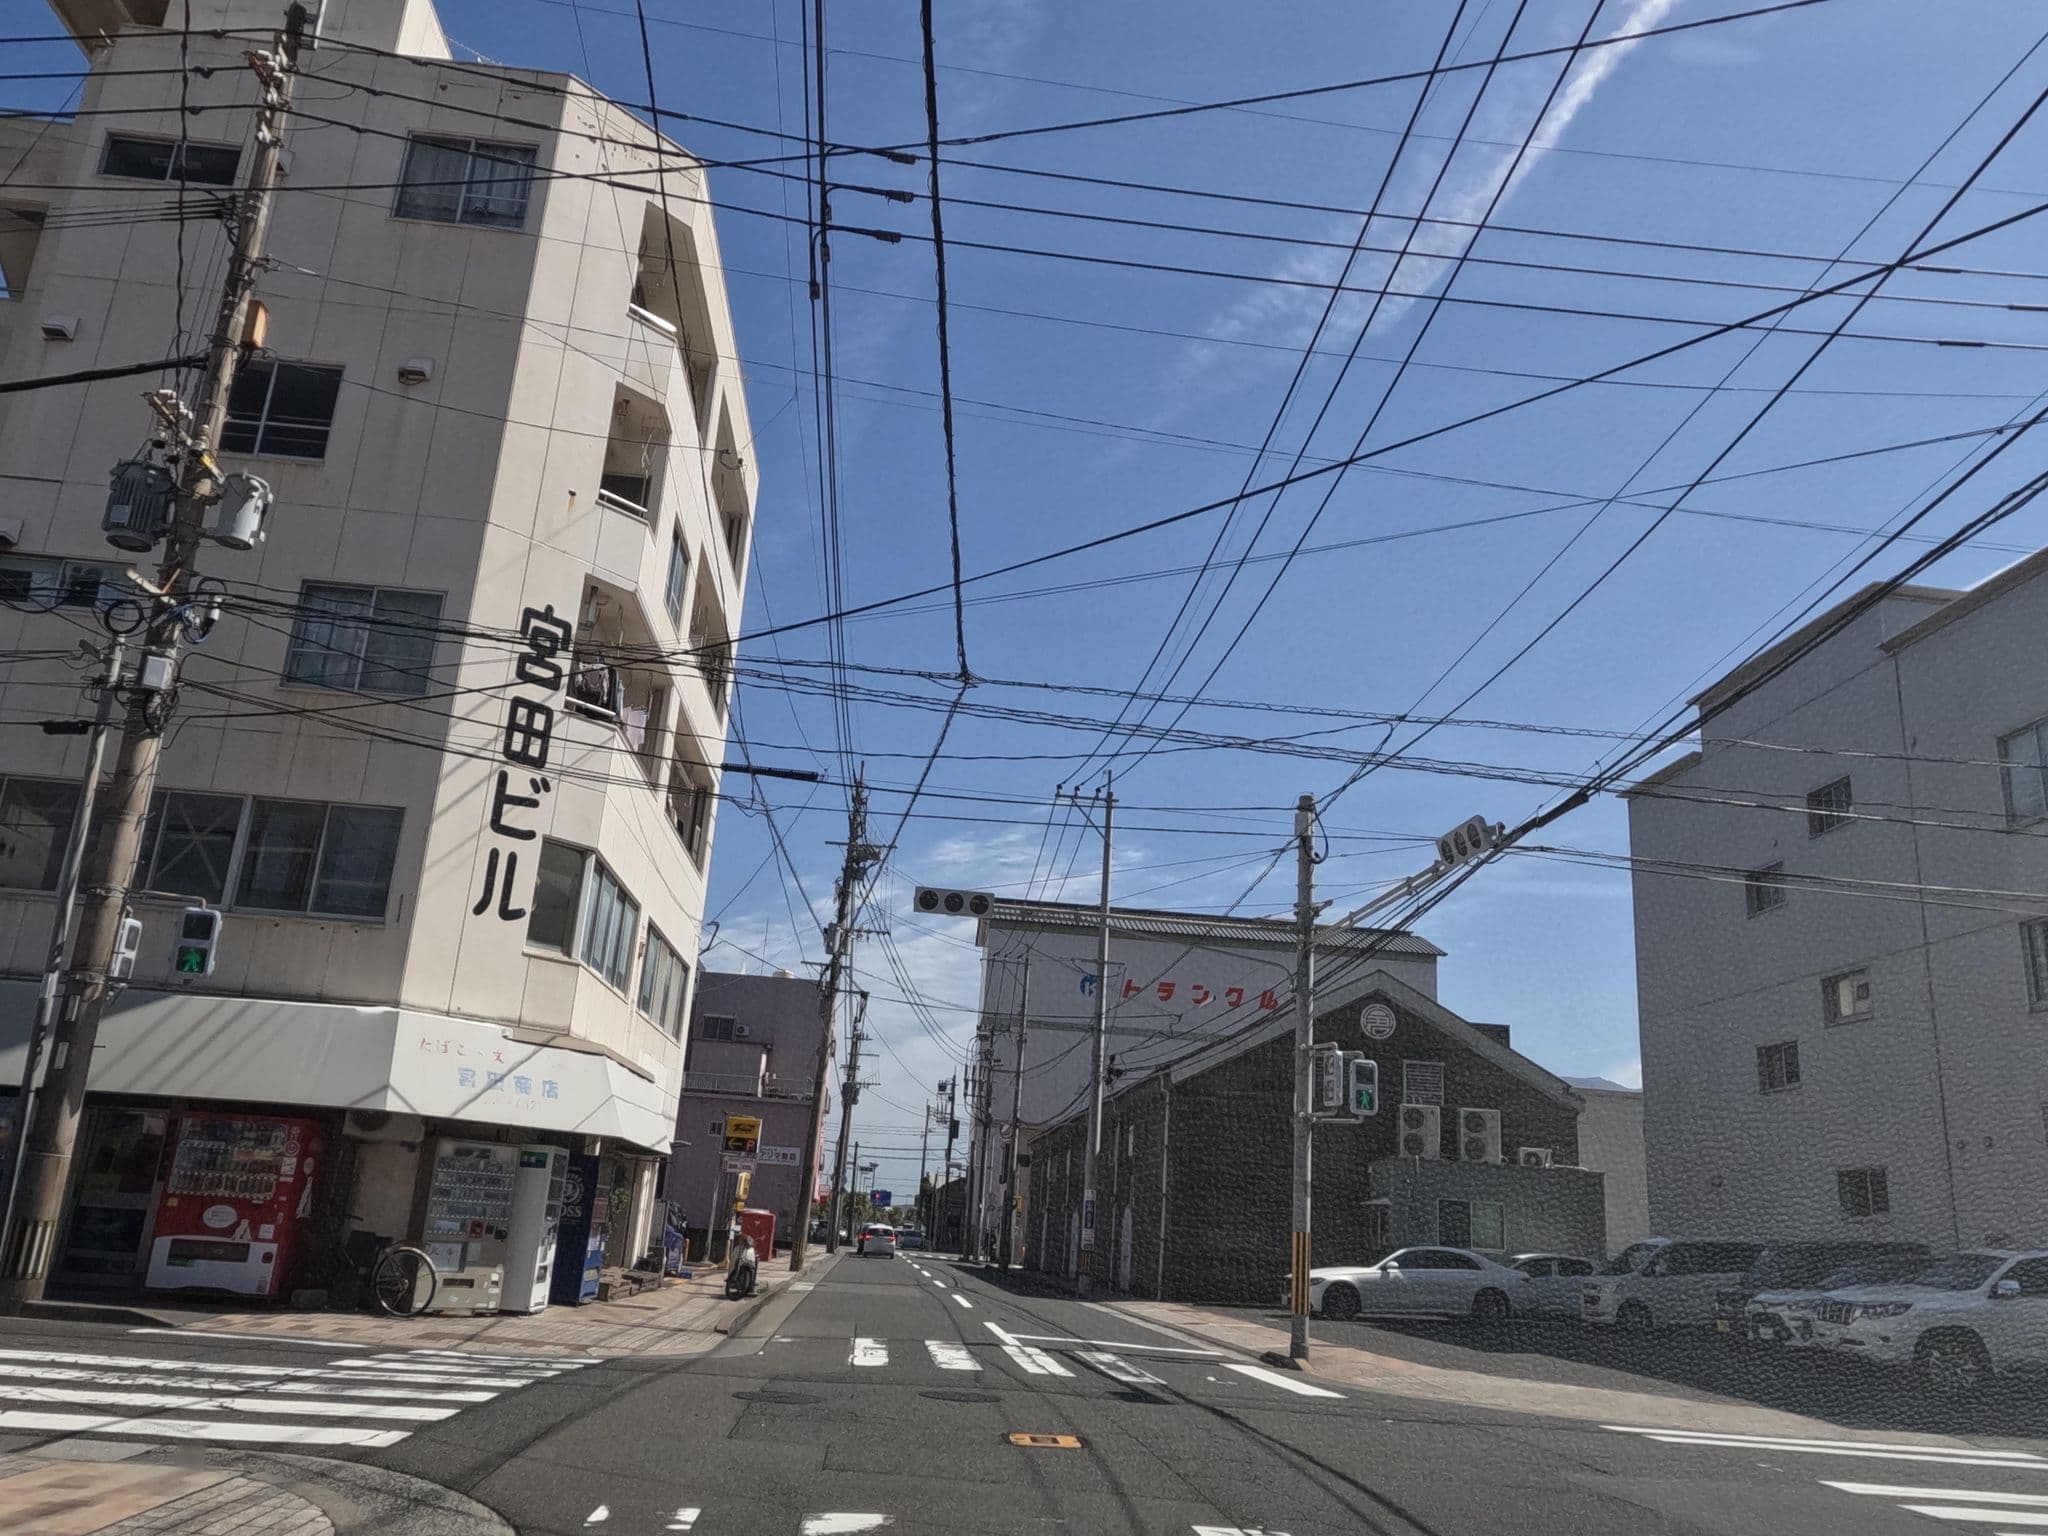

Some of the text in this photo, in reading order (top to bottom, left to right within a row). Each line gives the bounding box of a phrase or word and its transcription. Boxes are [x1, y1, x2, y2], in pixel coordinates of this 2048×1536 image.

[473, 604, 573, 921] 宮田ビル
[458, 1067, 559, 1100] 宮田商店
[560, 1204, 582, 1218] OSS
